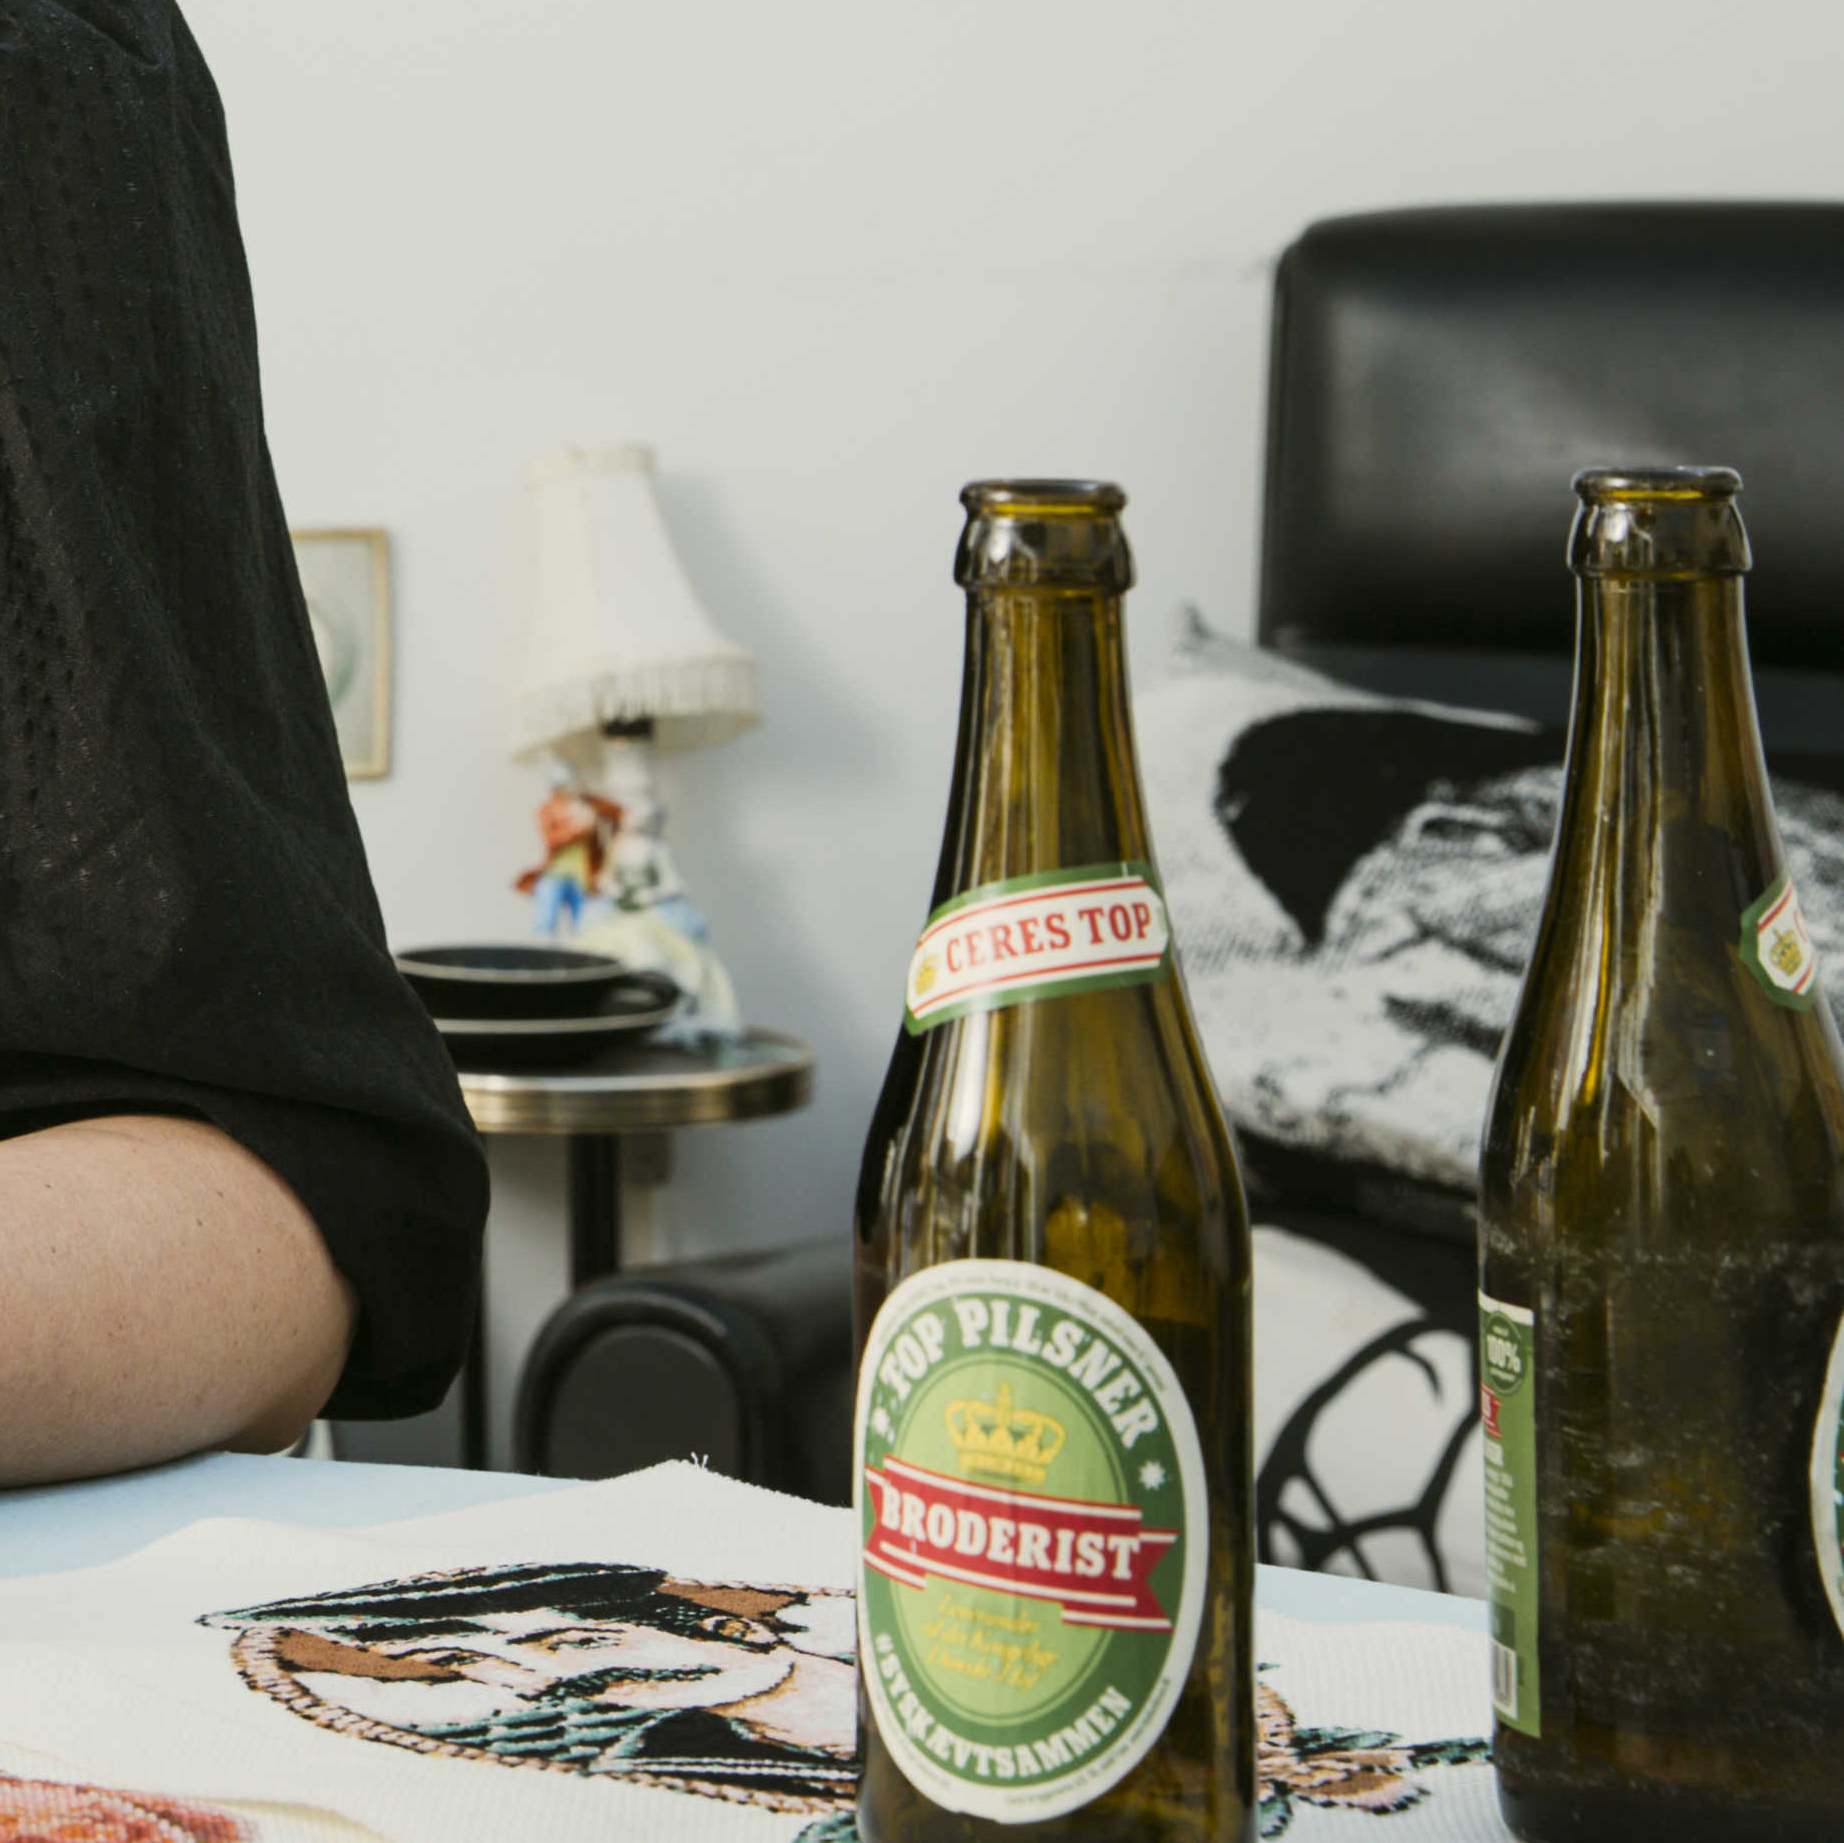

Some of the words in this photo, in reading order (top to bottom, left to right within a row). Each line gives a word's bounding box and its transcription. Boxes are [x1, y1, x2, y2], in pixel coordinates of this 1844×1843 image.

[946, 913, 1072, 973] CERES
[1079, 902, 1151, 946] TOP
[879, 1312, 944, 1401] TOP
[953, 1297, 1160, 1449] PILSNER
[880, 1483, 1141, 1580] BRODERIST
